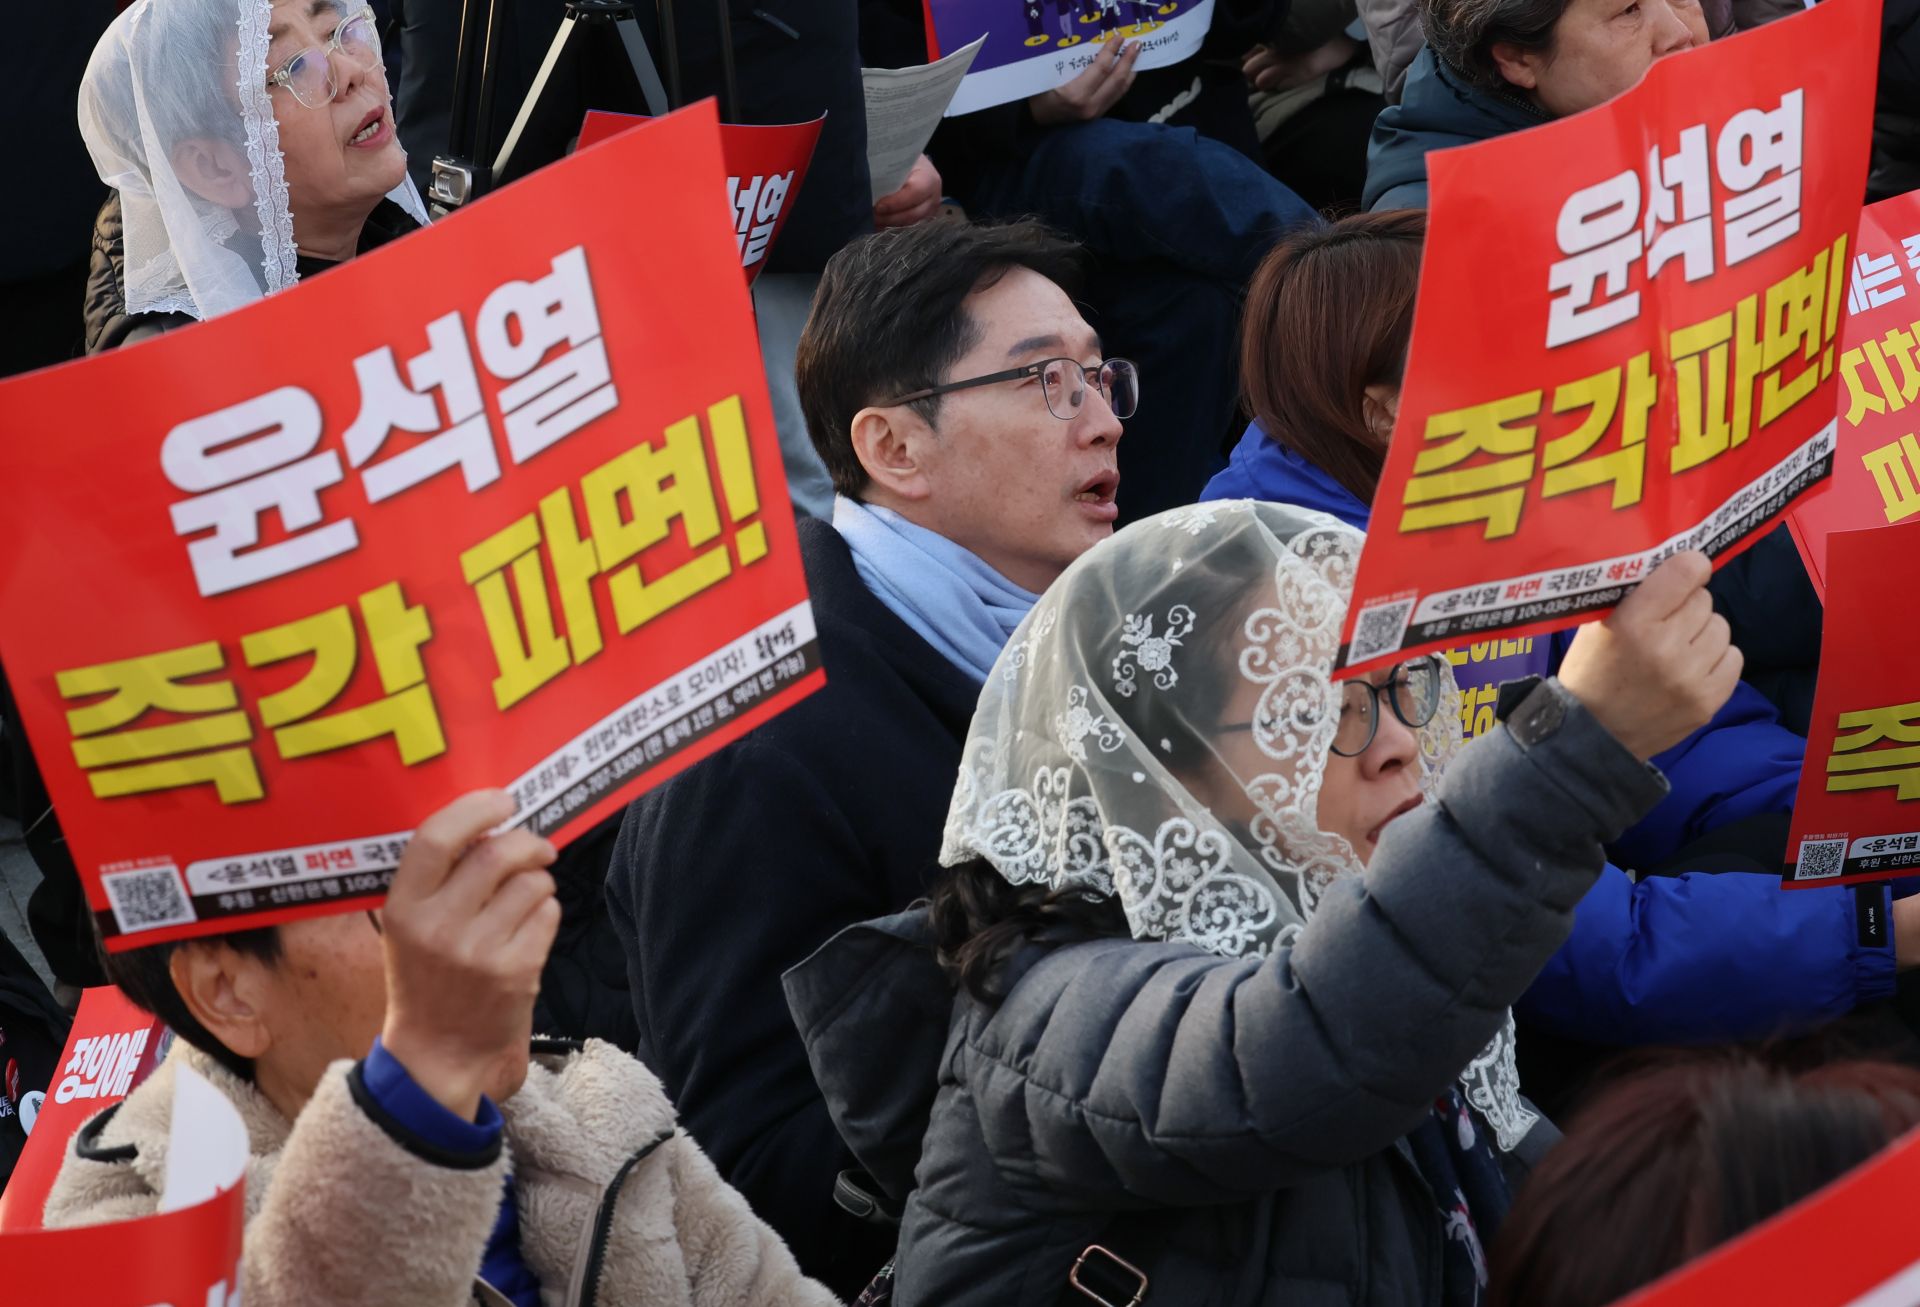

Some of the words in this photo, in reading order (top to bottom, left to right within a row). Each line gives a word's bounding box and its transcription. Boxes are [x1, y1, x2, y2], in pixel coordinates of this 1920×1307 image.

[1546, 88, 1803, 349] 윤석열
[1399, 351, 1657, 540] 즉각
[1671, 233, 1847, 474] 파면!
[160, 246, 618, 598] 윤석열
[55, 582, 446, 803] 즉각
[460, 395, 768, 711] 파면!
[1432, 585, 1500, 613] <윤석열
[1504, 577, 1543, 601] 파면
[1547, 567, 1602, 592] 국힘당
[1607, 558, 1643, 580] 해산
[688, 648, 747, 698] 모이자!
[208, 854, 298, 886] <윤석열
[304, 847, 356, 872] 파면
[1859, 857, 1880, 869] 후원
[1862, 835, 1918, 853] <윤석열
